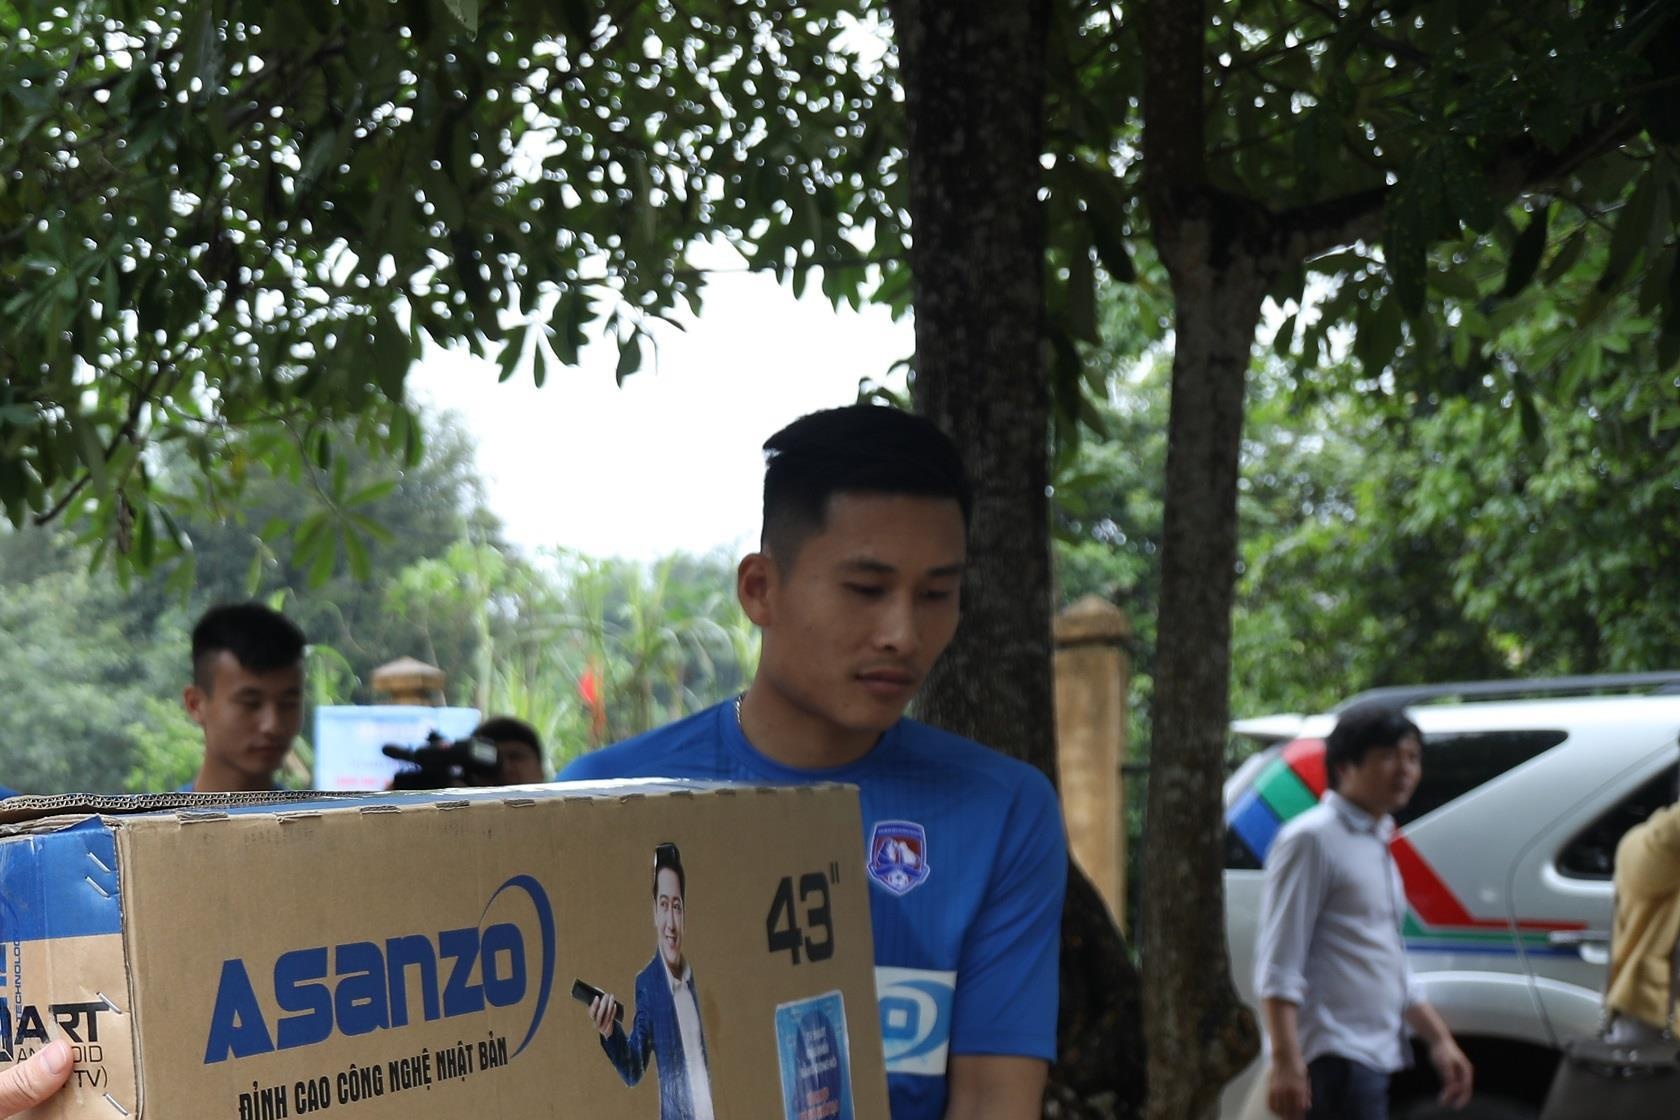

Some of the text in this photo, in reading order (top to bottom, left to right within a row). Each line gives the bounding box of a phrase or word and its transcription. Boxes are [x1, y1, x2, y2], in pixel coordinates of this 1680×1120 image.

[204, 922, 528, 1065] Asanzo
[294, 1075, 331, 1115] CAO
[337, 1063, 384, 1104] CÔNG
[388, 1048, 432, 1091] NGHỆ
[435, 1040, 474, 1082] NHẬT
[479, 1030, 508, 1071] BẢN
